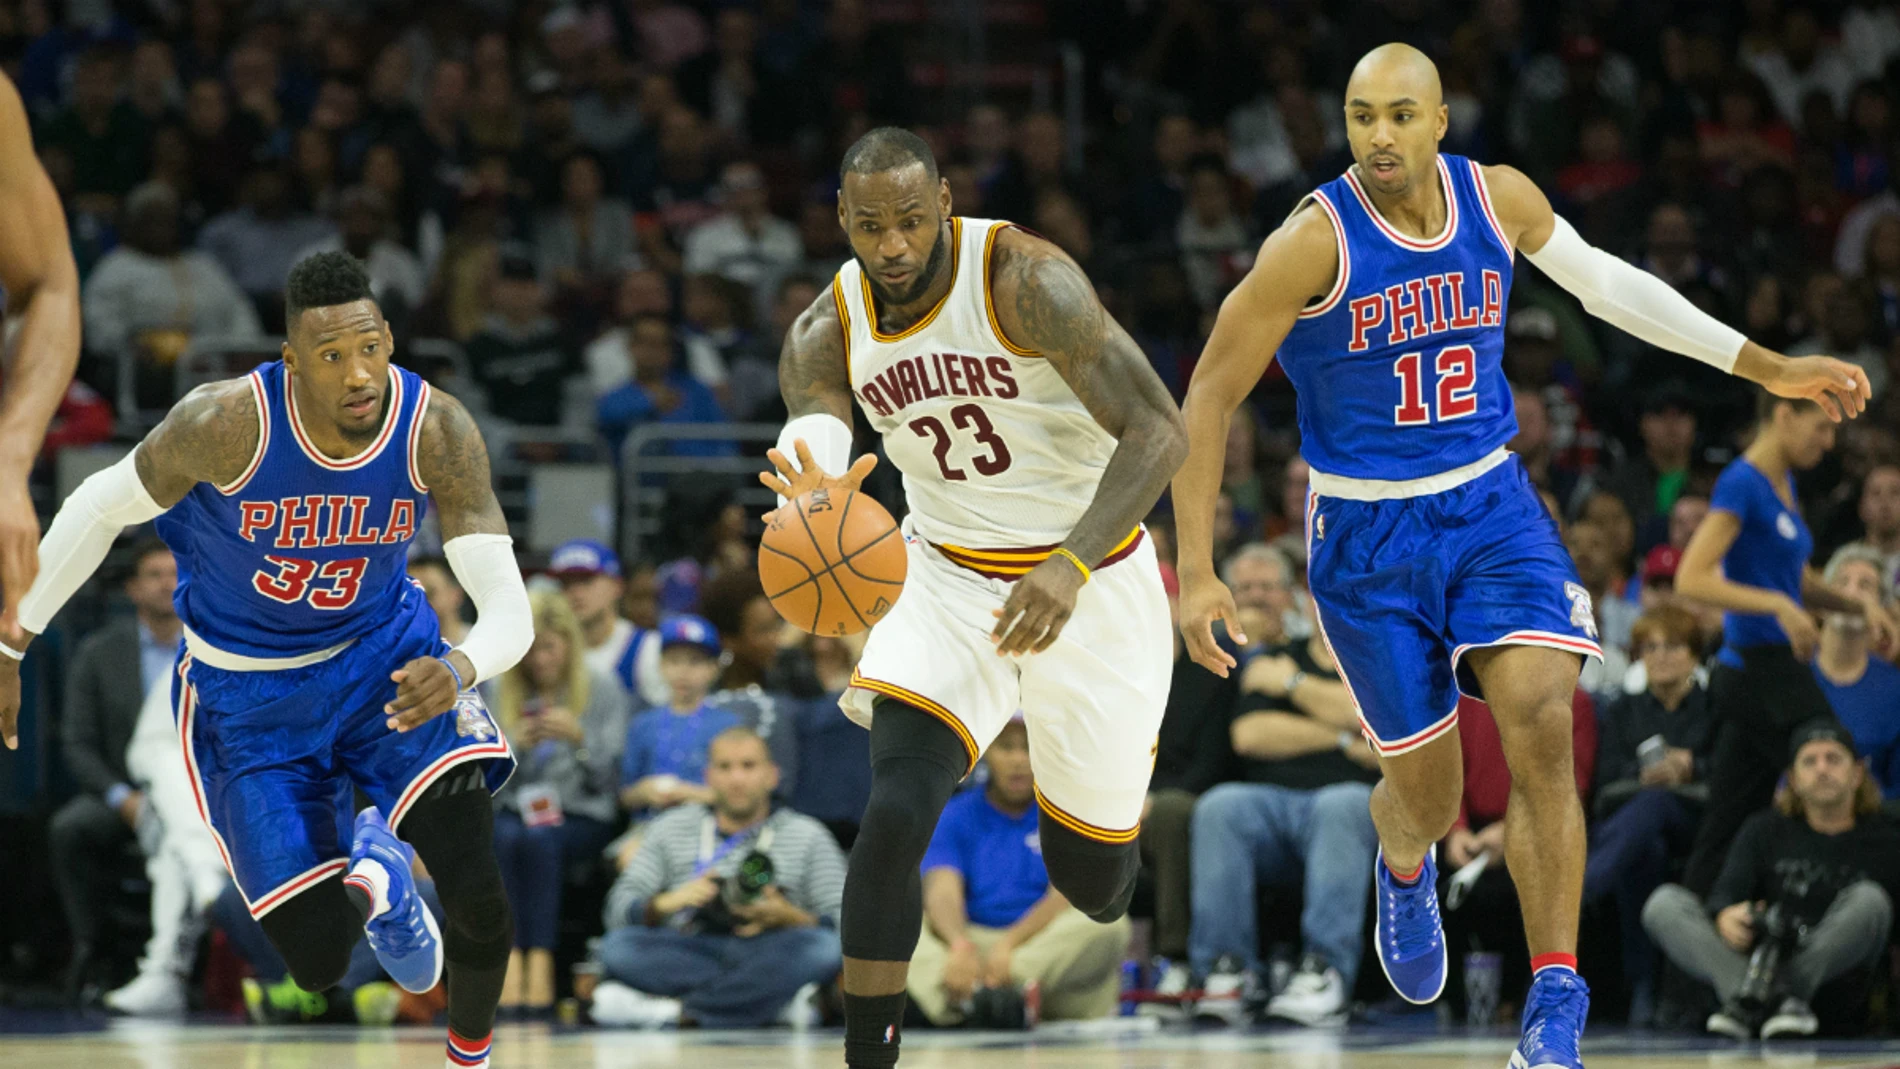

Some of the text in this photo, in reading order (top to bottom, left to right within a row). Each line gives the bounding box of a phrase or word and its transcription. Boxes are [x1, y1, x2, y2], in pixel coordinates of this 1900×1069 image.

[1349, 269, 1502, 352] PHILA
[852, 353, 1019, 417] AVALIERS
[1394, 344, 1478, 426] 12
[908, 403, 1012, 481] 23
[239, 495, 415, 548] PHILA
[252, 554, 369, 610] 33
